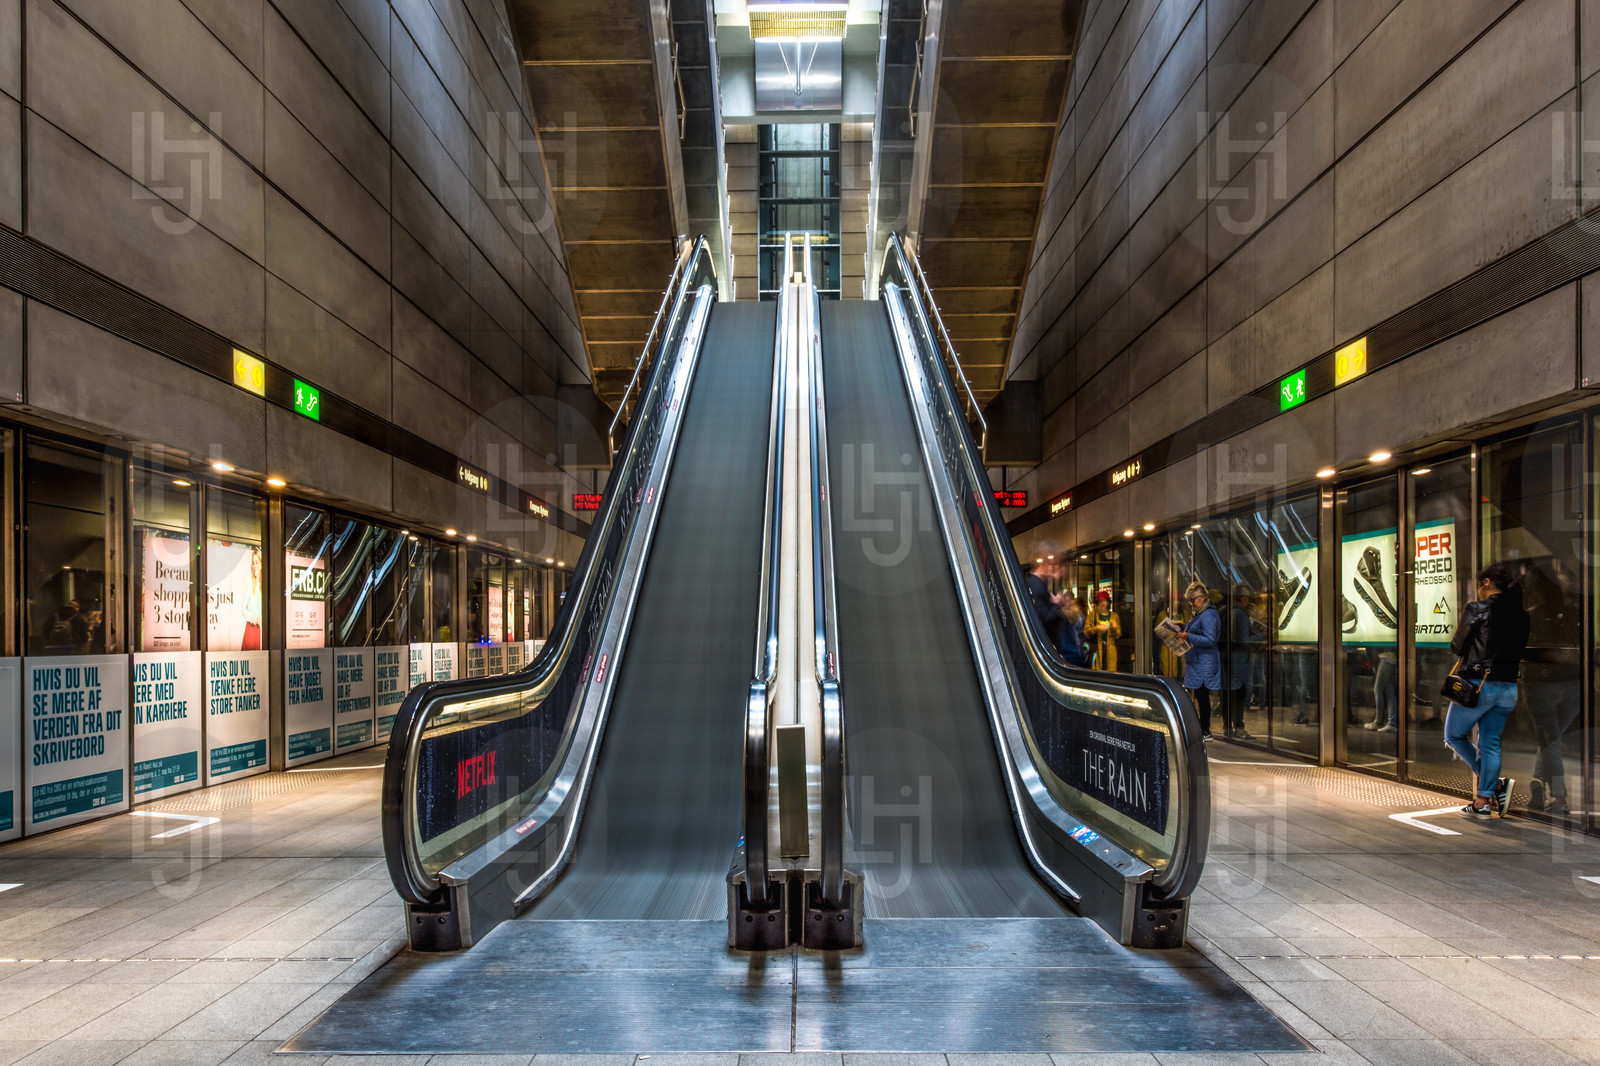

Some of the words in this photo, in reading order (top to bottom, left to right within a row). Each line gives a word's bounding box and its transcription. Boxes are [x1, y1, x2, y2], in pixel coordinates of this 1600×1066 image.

[1004, 498, 1010, 506] 4
[1013, 491, 1025, 499] min
[215, 587, 234, 609] just
[154, 605, 160, 624] 3
[150, 663, 161, 681] DU
[164, 662, 177, 680] VIL
[211, 661, 227, 678] HVIS
[230, 660, 238, 676] DU
[240, 660, 250, 675] VIL
[289, 656, 301, 671] HVIS
[303, 656, 310, 671] DU
[311, 656, 320, 670] VIL
[33, 668, 61, 691] HVIS
[65, 667, 80, 688] DU
[84, 667, 101, 687] VIL
[211, 679, 235, 697] TÆNKE
[237, 677, 256, 694] FLERE
[289, 673, 303, 688] HAVE
[305, 672, 321, 687] NOGET
[155, 682, 174, 701] MED
[289, 690, 300, 705] FRA
[33, 694, 48, 716] SE
[52, 691, 84, 714] MERE
[88, 690, 102, 710] AF
[146, 701, 187, 723] KARRIERE
[211, 697, 233, 716] STORE
[235, 694, 260, 713] TANKER
[33, 715, 78, 741] VERDEN
[82, 712, 103, 734] FRA
[106, 710, 122, 731] DIT
[33, 735, 104, 766] SKRIVEBORD
[458, 751, 496, 800] NETFLIX
[1082, 748, 1104, 790] THE
[1108, 758, 1147, 813] RAIN
